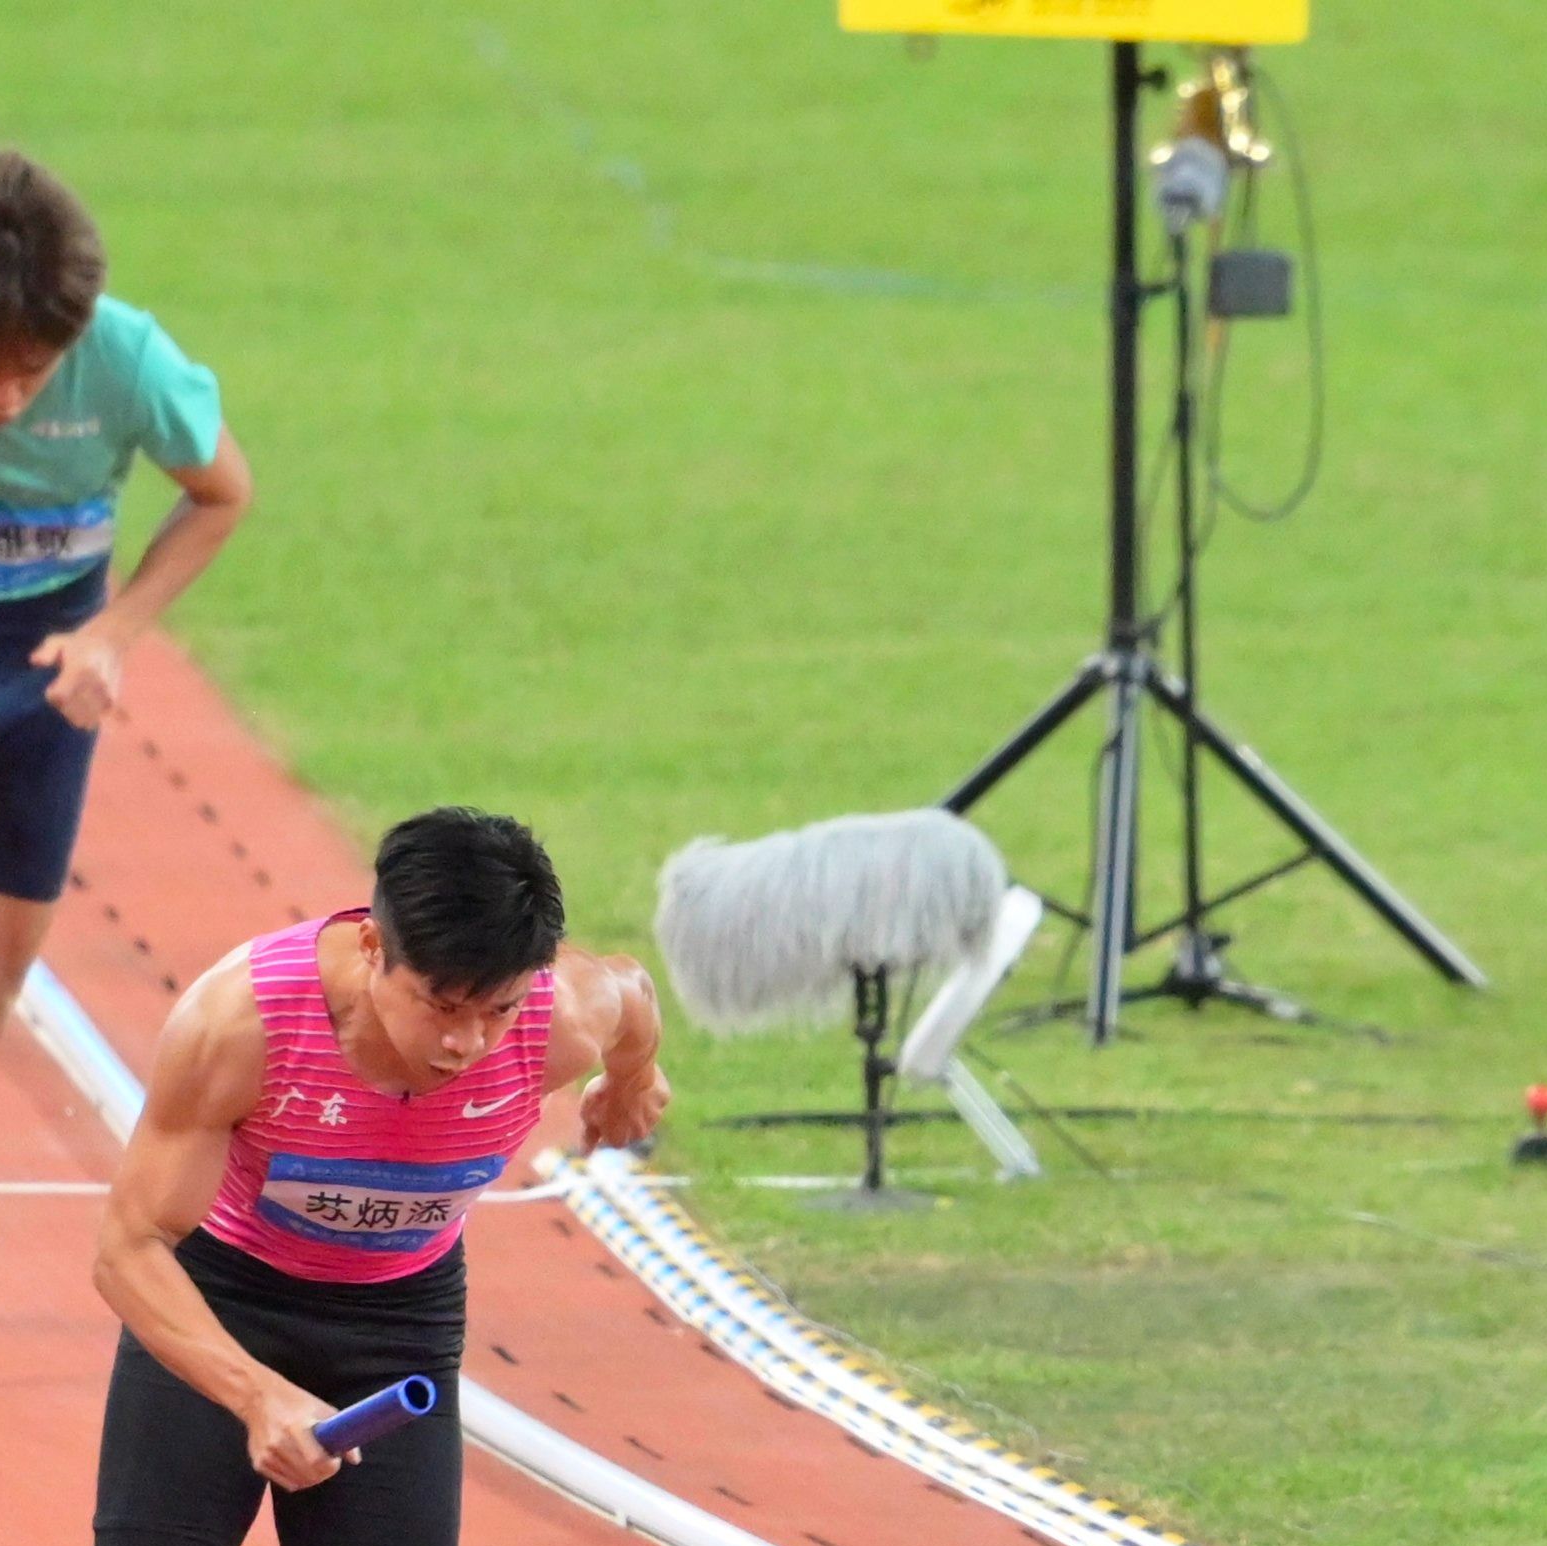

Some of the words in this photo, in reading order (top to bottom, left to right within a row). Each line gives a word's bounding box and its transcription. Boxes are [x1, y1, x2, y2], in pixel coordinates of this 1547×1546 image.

[270, 1086, 348, 1126] 广东
[306, 1191, 452, 1229] 苏炳添
